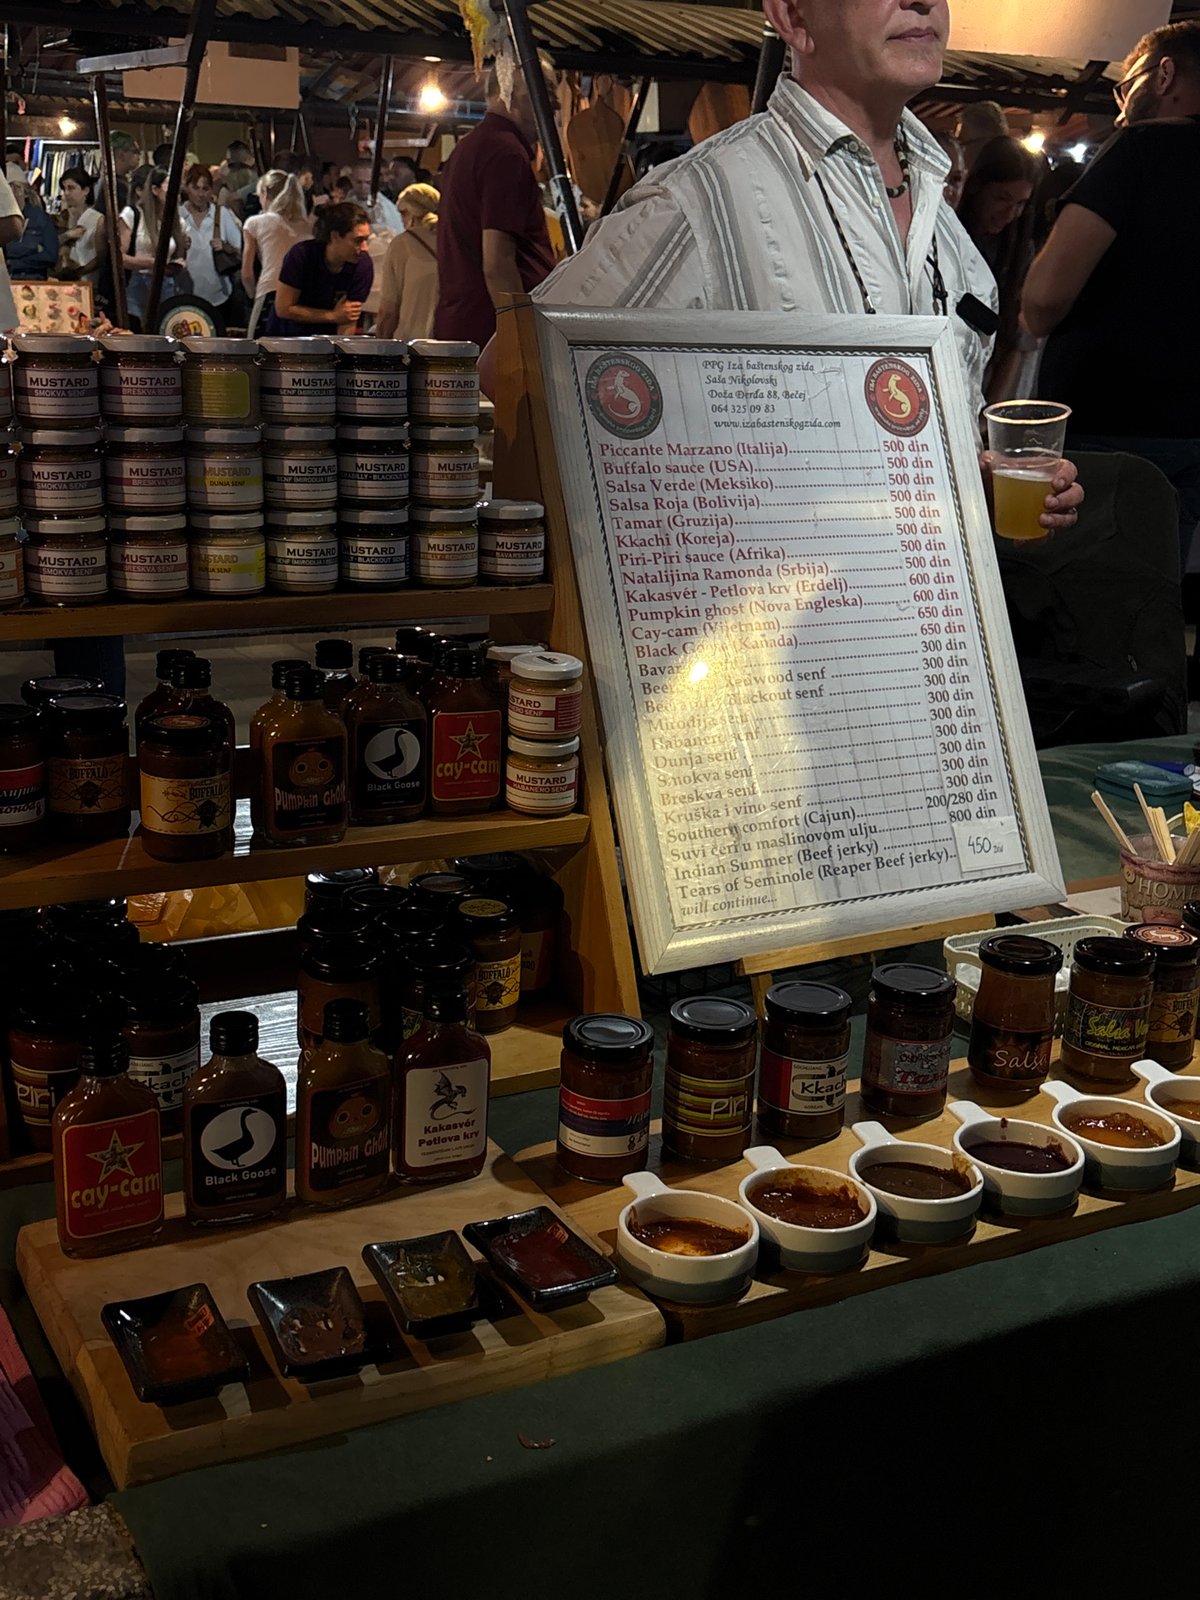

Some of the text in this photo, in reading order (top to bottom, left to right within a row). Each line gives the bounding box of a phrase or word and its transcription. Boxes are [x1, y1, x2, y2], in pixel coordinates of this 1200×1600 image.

[702, 361, 723, 371] PPG
[726, 361, 742, 370] Iza
[29, 376, 90, 387] MUSTARD
[119, 376, 177, 386] MUSTARD
[346, 379, 400, 388] MUSTARD
[424, 379, 475, 388] MUSTARD
[705, 375, 778, 386] Saša Nikolovski
[767, 391, 781, 401] 88,
[711, 404, 774, 413] 064 325 09 83
[600, 443, 662, 457] Piccante
[666, 443, 732, 455] Marzano
[882, 441, 903, 452] 500
[907, 441, 928, 451] din
[129, 467, 183, 477] MUSTARD
[205, 466, 251, 476] MUSTARD
[355, 463, 406, 471] MUSTARD
[603, 462, 661, 476] Buffalo
[665, 464, 705, 474] sauce
[887, 457, 907, 468] 500
[911, 457, 932, 468] din
[31, 470, 92, 481] MUSTARD
[606, 481, 645, 493] Salsa
[651, 480, 695, 492] Verde
[889, 474, 909, 485] 500
[913, 473, 933, 484] din
[609, 499, 648, 511] Salsa
[654, 498, 689, 514] Roja
[890, 490, 910, 502] 500
[914, 490, 934, 501] din
[614, 517, 662, 529] Tamar
[894, 507, 915, 517] 500
[918, 506, 938, 517] din
[616, 534, 670, 548] Kkachi
[896, 524, 916, 535] 500
[920, 523, 940, 534] din
[286, 547, 336, 557] MUSTARD
[343, 546, 395, 555] MUSTARD
[427, 543, 475, 552] MUSTARD
[496, 541, 542, 550] MUSTARD
[121, 554, 178, 564] MUSTARD
[619, 552, 681, 567] Piri-Piri
[685, 552, 724, 564] sauce
[901, 540, 921, 552] 500
[925, 539, 945, 551] din
[38, 556, 98, 567] MUSTARD
[623, 569, 699, 589] Natalijina
[703, 565, 772, 581] Ramonda
[905, 558, 925, 569] 500
[929, 556, 950, 568] din
[627, 587, 698, 604] Kakasvér
[711, 583, 764, 599] Petlova
[768, 582, 791, 595] krv
[909, 574, 929, 585] 600
[933, 572, 953, 584] din
[629, 605, 700, 625] Pumpkin
[703, 602, 744, 620] ghost
[749, 599, 792, 617] (Nova
[913, 591, 933, 603] 600
[937, 588, 958, 601] din
[631, 624, 697, 643] Cay-cam
[917, 607, 938, 619] 650
[941, 605, 962, 617] din
[636, 621, 964, 658] Black 650 din
[921, 640, 941, 653] 300
[796, 657, 942, 681] senf 300
[794, 675, 946, 699] senf 300
[928, 692, 949, 704] 300
[930, 708, 951, 721] 300
[935, 725, 956, 738] 300
[939, 742, 960, 754] 300
[435, 759, 500, 782] cay-cam
[942, 759, 962, 771] 300
[367, 780, 421, 792] Black Goose
[515, 774, 567, 785] MUSTARD
[665, 807, 720, 825] Kruška
[769, 796, 802, 811] senf
[945, 775, 966, 788] 300
[742, 814, 799, 833] comfort
[926, 791, 973, 812] 200/280
[673, 847, 705, 863] Suvi
[756, 828, 844, 852] maslinovom
[949, 810, 970, 823] 800
[974, 806, 995, 819] din
[966, 833, 993, 856] 450
[675, 840, 878, 881] Indian Summer (Beef jerky)
[678, 882, 720, 900] Tears
[723, 878, 738, 893] of
[743, 866, 813, 890] Seminole
[817, 858, 872, 882] (Reaper
[875, 853, 905, 869] Beef
[682, 902, 708, 917] will
[1086, 1017, 1130, 1040] Salsa
[418, 1129, 480, 1147] Petlova krv
[205, 1166, 278, 1187] Black Goose
[71, 1172, 161, 1208] cay-cam
